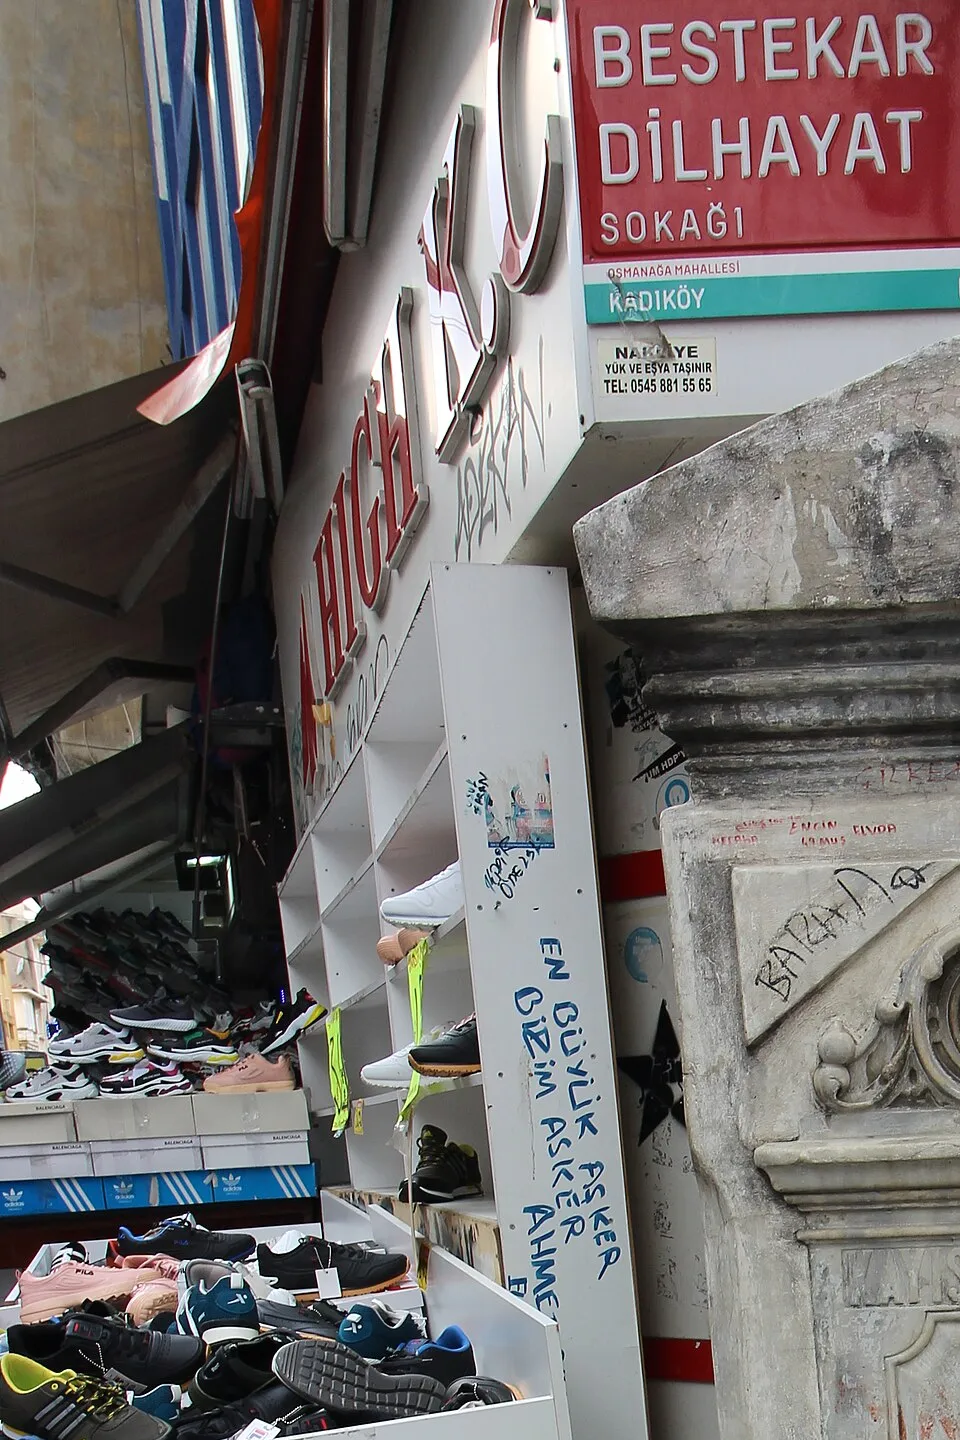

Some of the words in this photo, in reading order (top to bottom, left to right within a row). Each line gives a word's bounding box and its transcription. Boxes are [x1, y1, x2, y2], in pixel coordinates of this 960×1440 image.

[593, 13, 934, 89] BESTEKAR
[599, 108, 923, 185] DİLHAYAT
[600, 202, 744, 245] SOKAĞI
[608, 263, 672, 279] OSMANAĞA
[675, 260, 740, 276] MAHALLESİ
[610, 286, 704, 313] KADIKÖY
[604, 380, 628, 393] TEL:
[631, 379, 657, 393] 0545
[660, 378, 678, 393] 881
[683, 378, 695, 392] 55
[698, 378, 712, 392] 65
[605, 361, 626, 374] YÜK
[629, 362, 642, 374] VE
[645, 362, 670, 376] EŞYA
[673, 362, 712, 376] TAŞINIR
[540, 937, 571, 981] EN
[553, 1001, 603, 1140] BÜYÜK
[35, 1103, 66, 1111] BALENCIAGA
[75, 1268, 94, 1276] FILA
[522, 1204, 559, 1320] AHME
